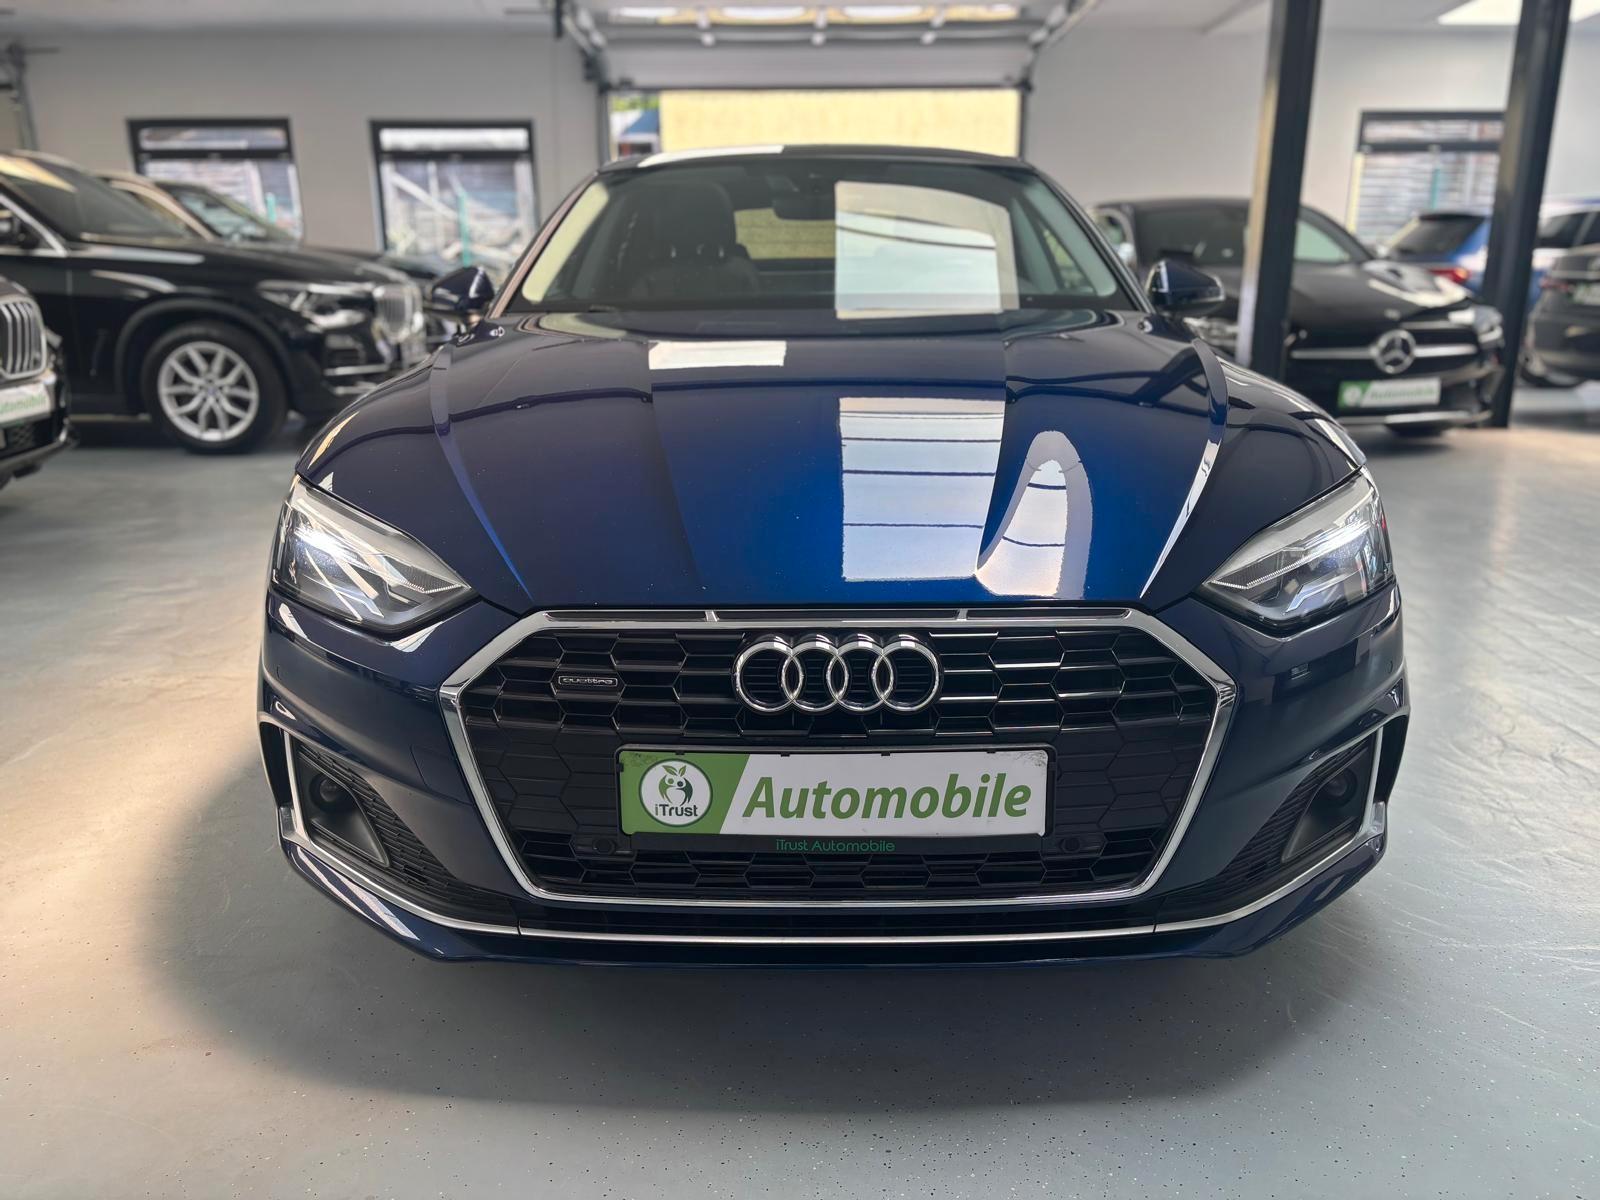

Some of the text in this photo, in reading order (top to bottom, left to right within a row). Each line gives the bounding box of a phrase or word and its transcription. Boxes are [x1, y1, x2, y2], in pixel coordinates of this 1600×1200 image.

[743, 773, 1031, 818] Automobile
[655, 803, 698, 816] iTrust
[776, 839, 895, 852] iTrust Automobile
